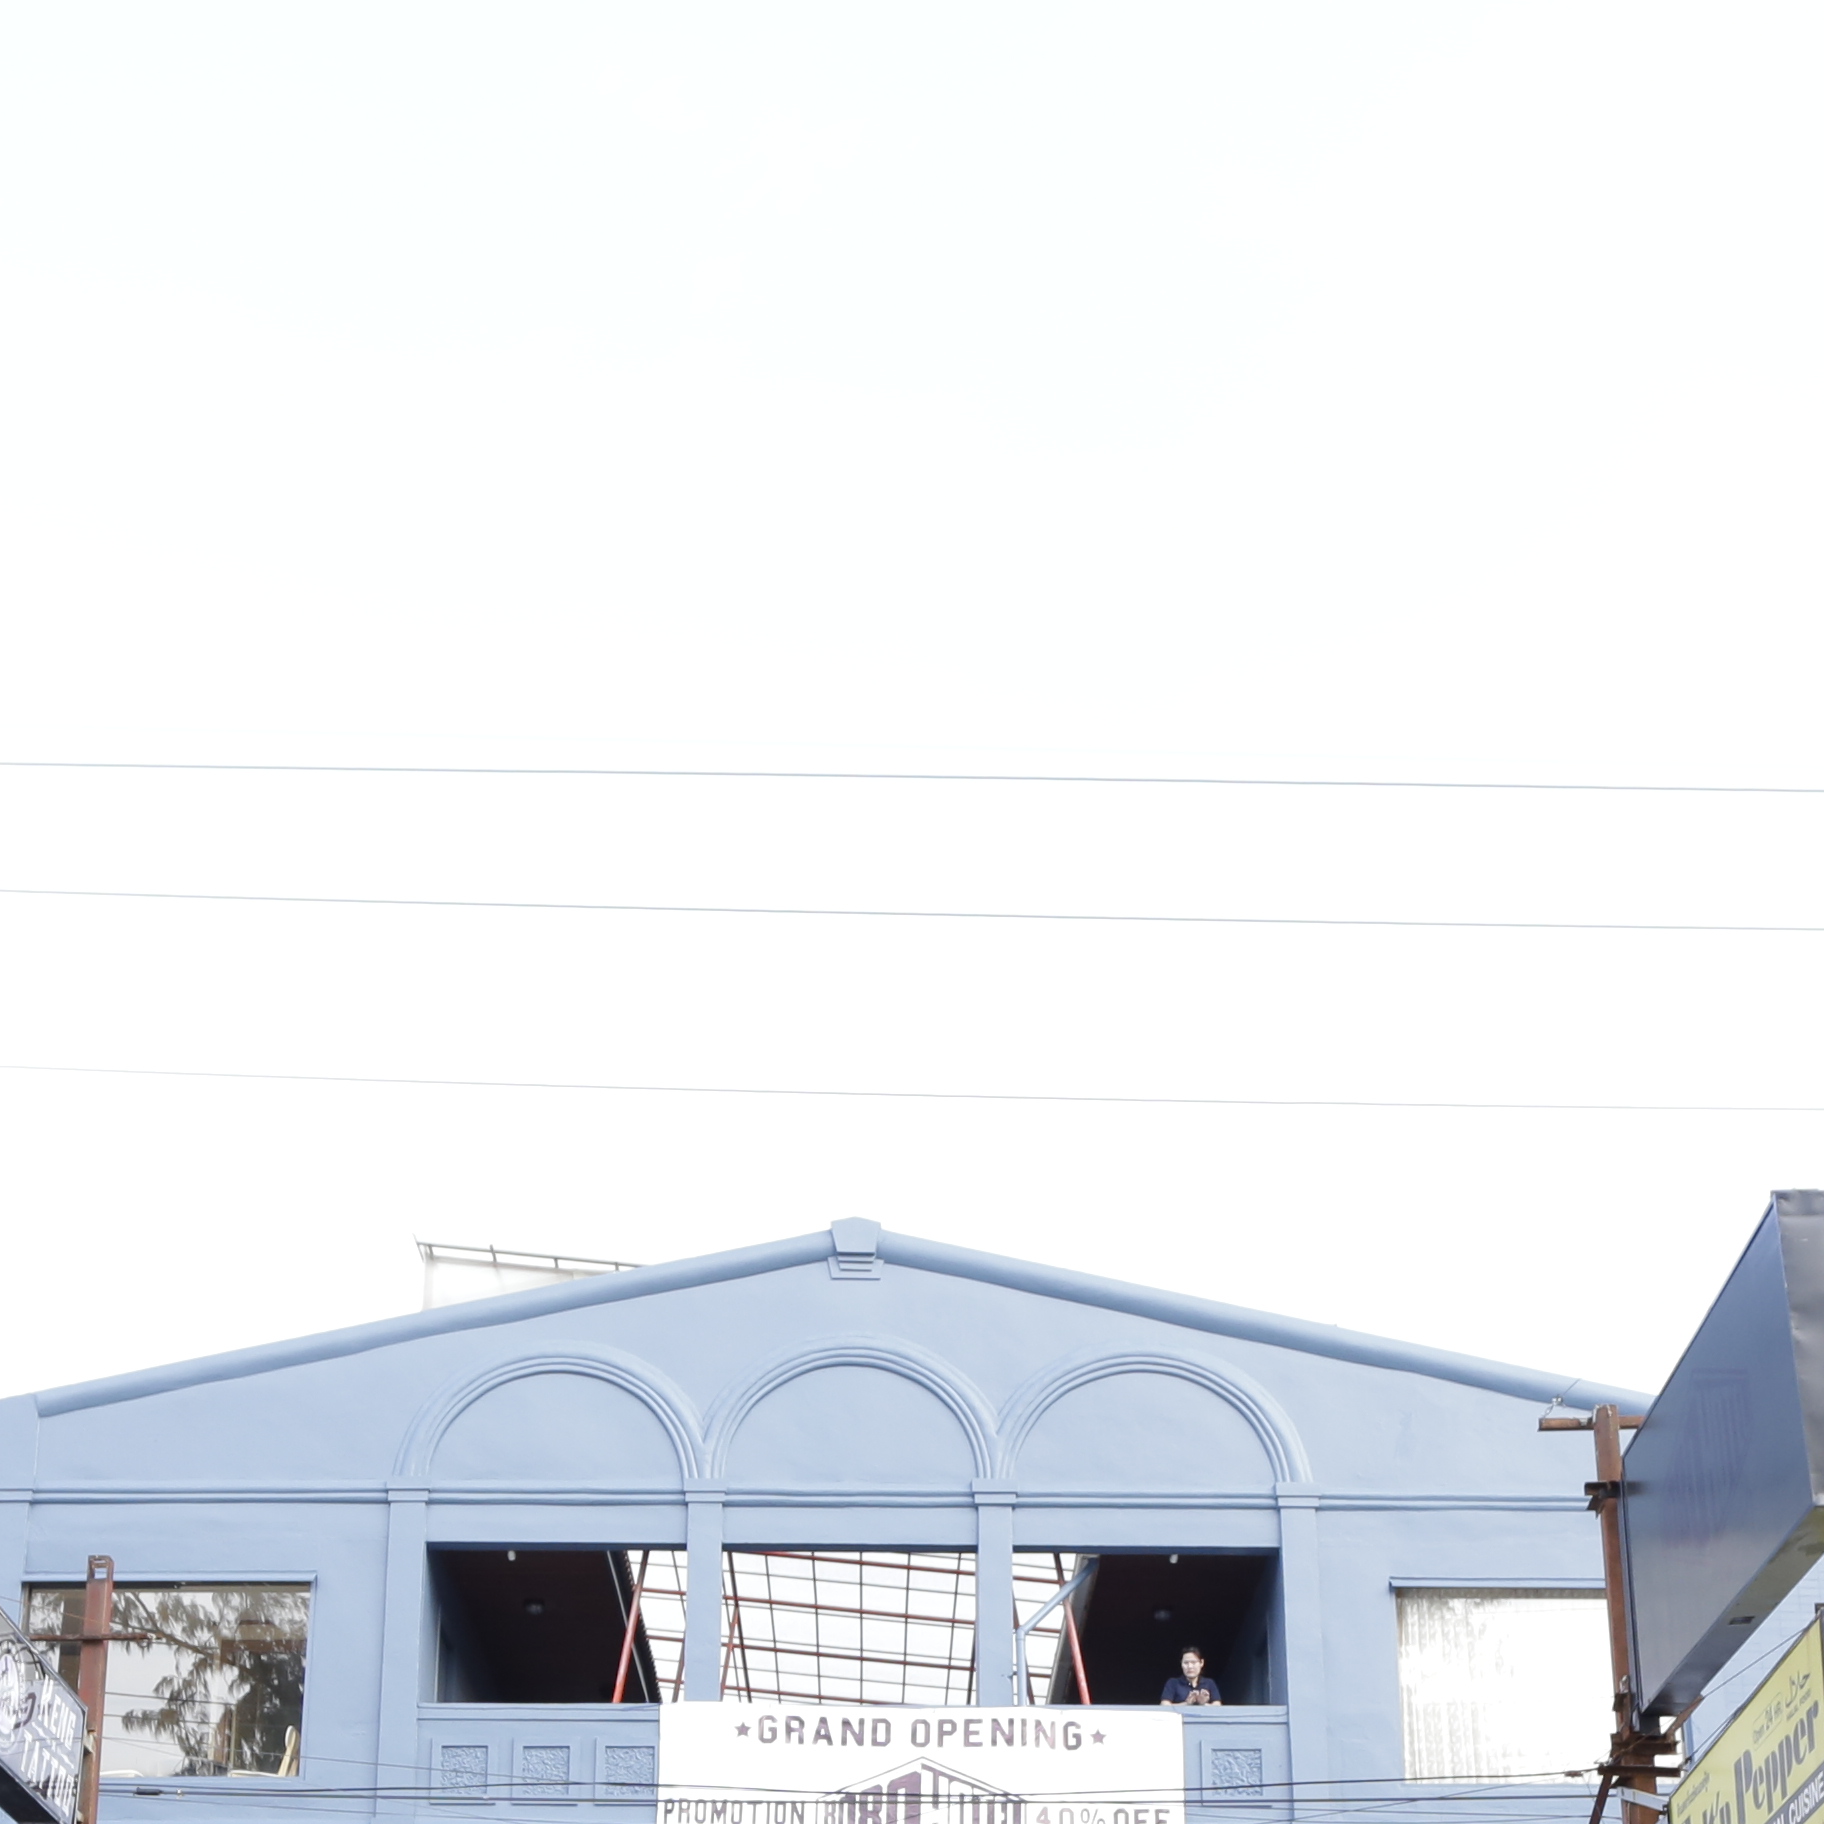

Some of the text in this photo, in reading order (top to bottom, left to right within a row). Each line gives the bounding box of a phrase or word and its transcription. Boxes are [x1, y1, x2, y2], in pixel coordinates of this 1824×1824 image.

[39, 1674, 77, 1750] KENG
[757, 1714, 1084, 1752] GRAND OPENING
[21, 1730, 76, 1817] TATTOO
